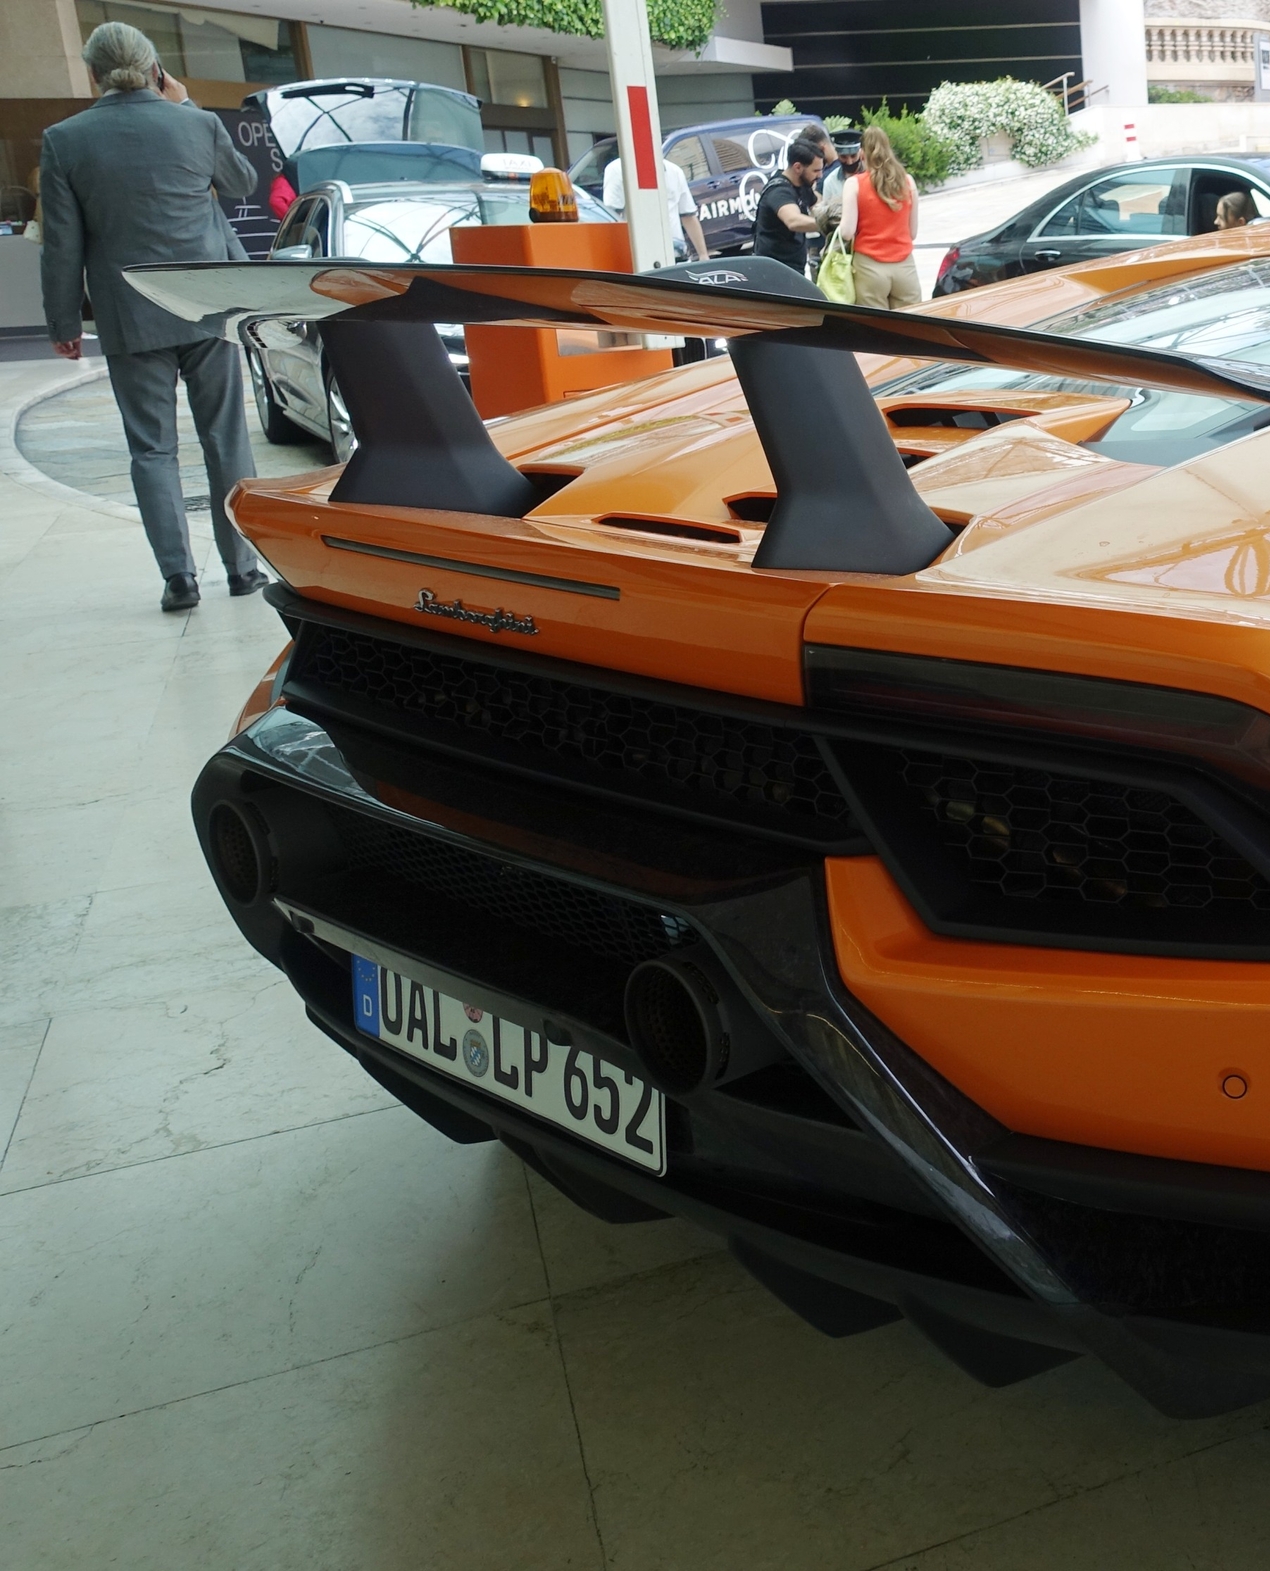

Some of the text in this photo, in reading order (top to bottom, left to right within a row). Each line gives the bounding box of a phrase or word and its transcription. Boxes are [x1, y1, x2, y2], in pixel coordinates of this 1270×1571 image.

[412, 586, 540, 636] Lamborghini
[362, 993, 373, 1017] D
[492, 1013, 548, 1098] LP
[563, 1046, 654, 1155] 652
